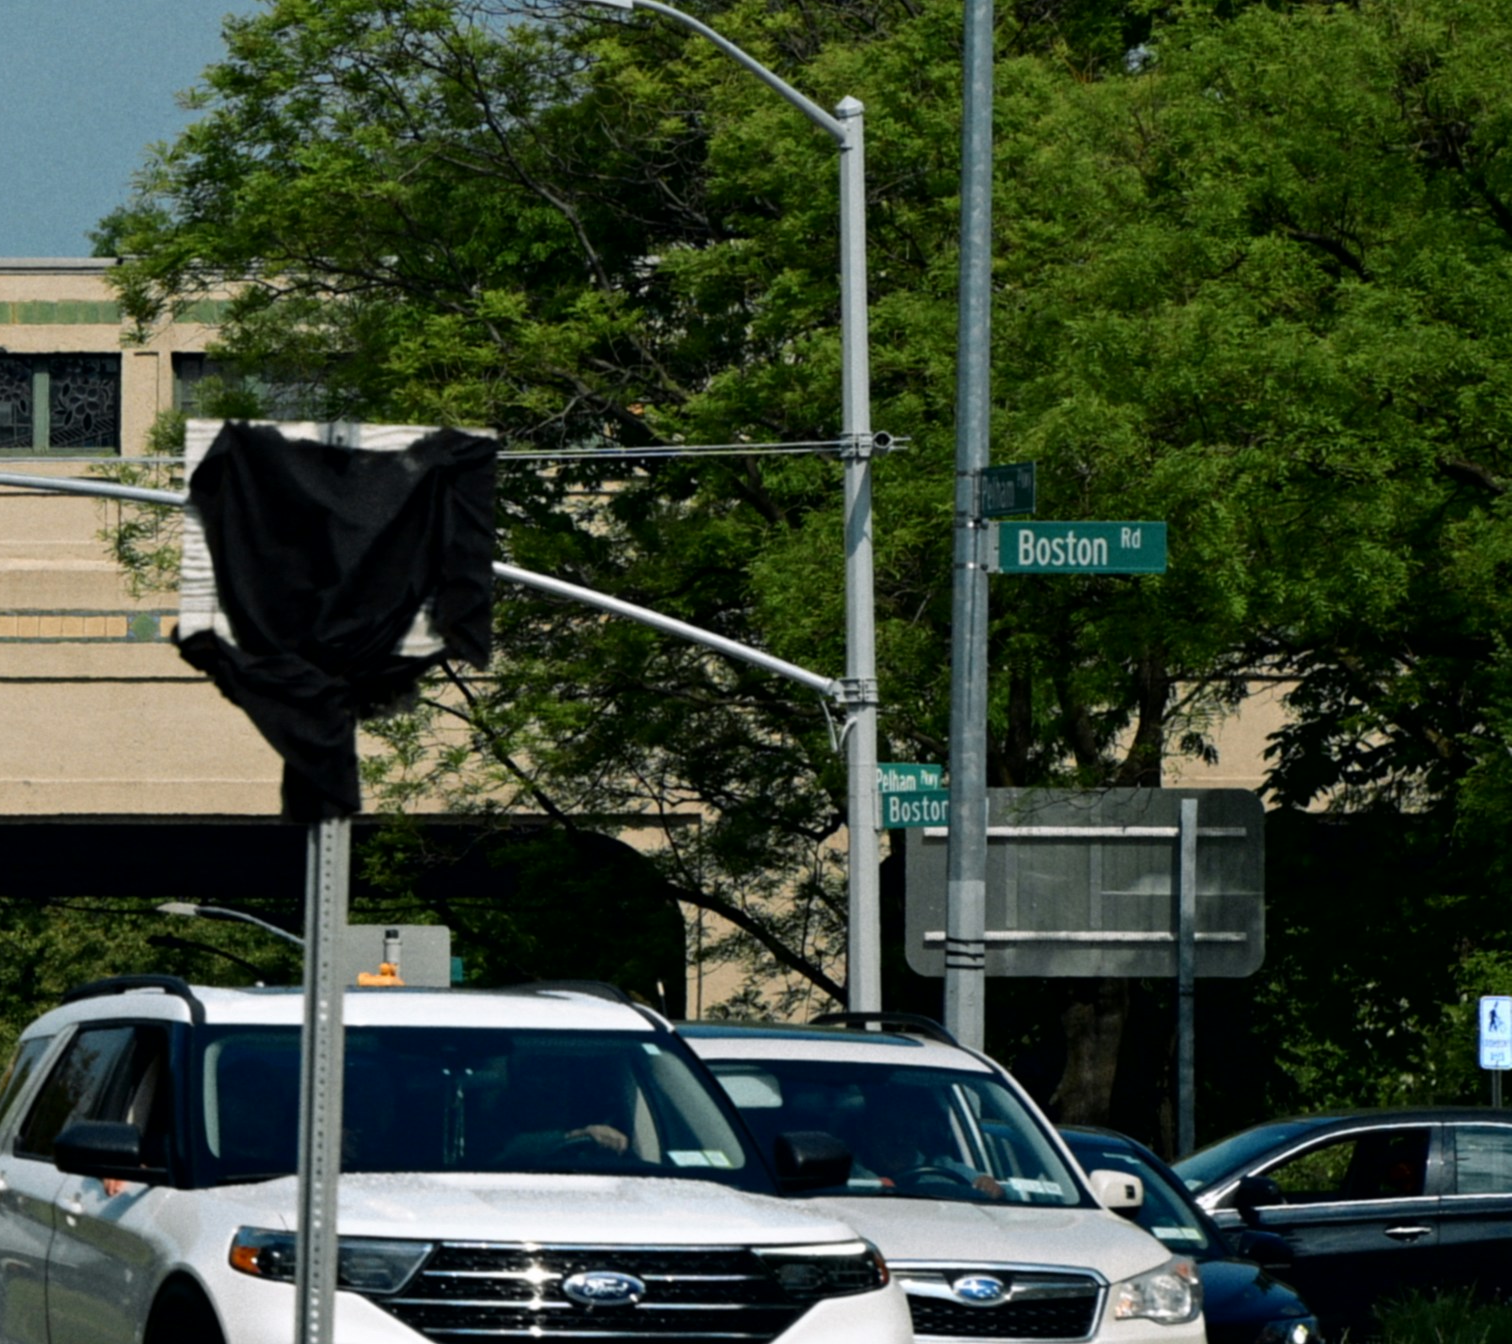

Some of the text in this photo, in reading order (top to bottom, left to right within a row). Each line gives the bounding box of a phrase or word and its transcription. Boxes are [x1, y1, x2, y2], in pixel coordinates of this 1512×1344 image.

[981, 474, 1015, 511] Pelham
[1018, 527, 1142, 566] Boston Rd
[876, 767, 917, 793] Pelham
